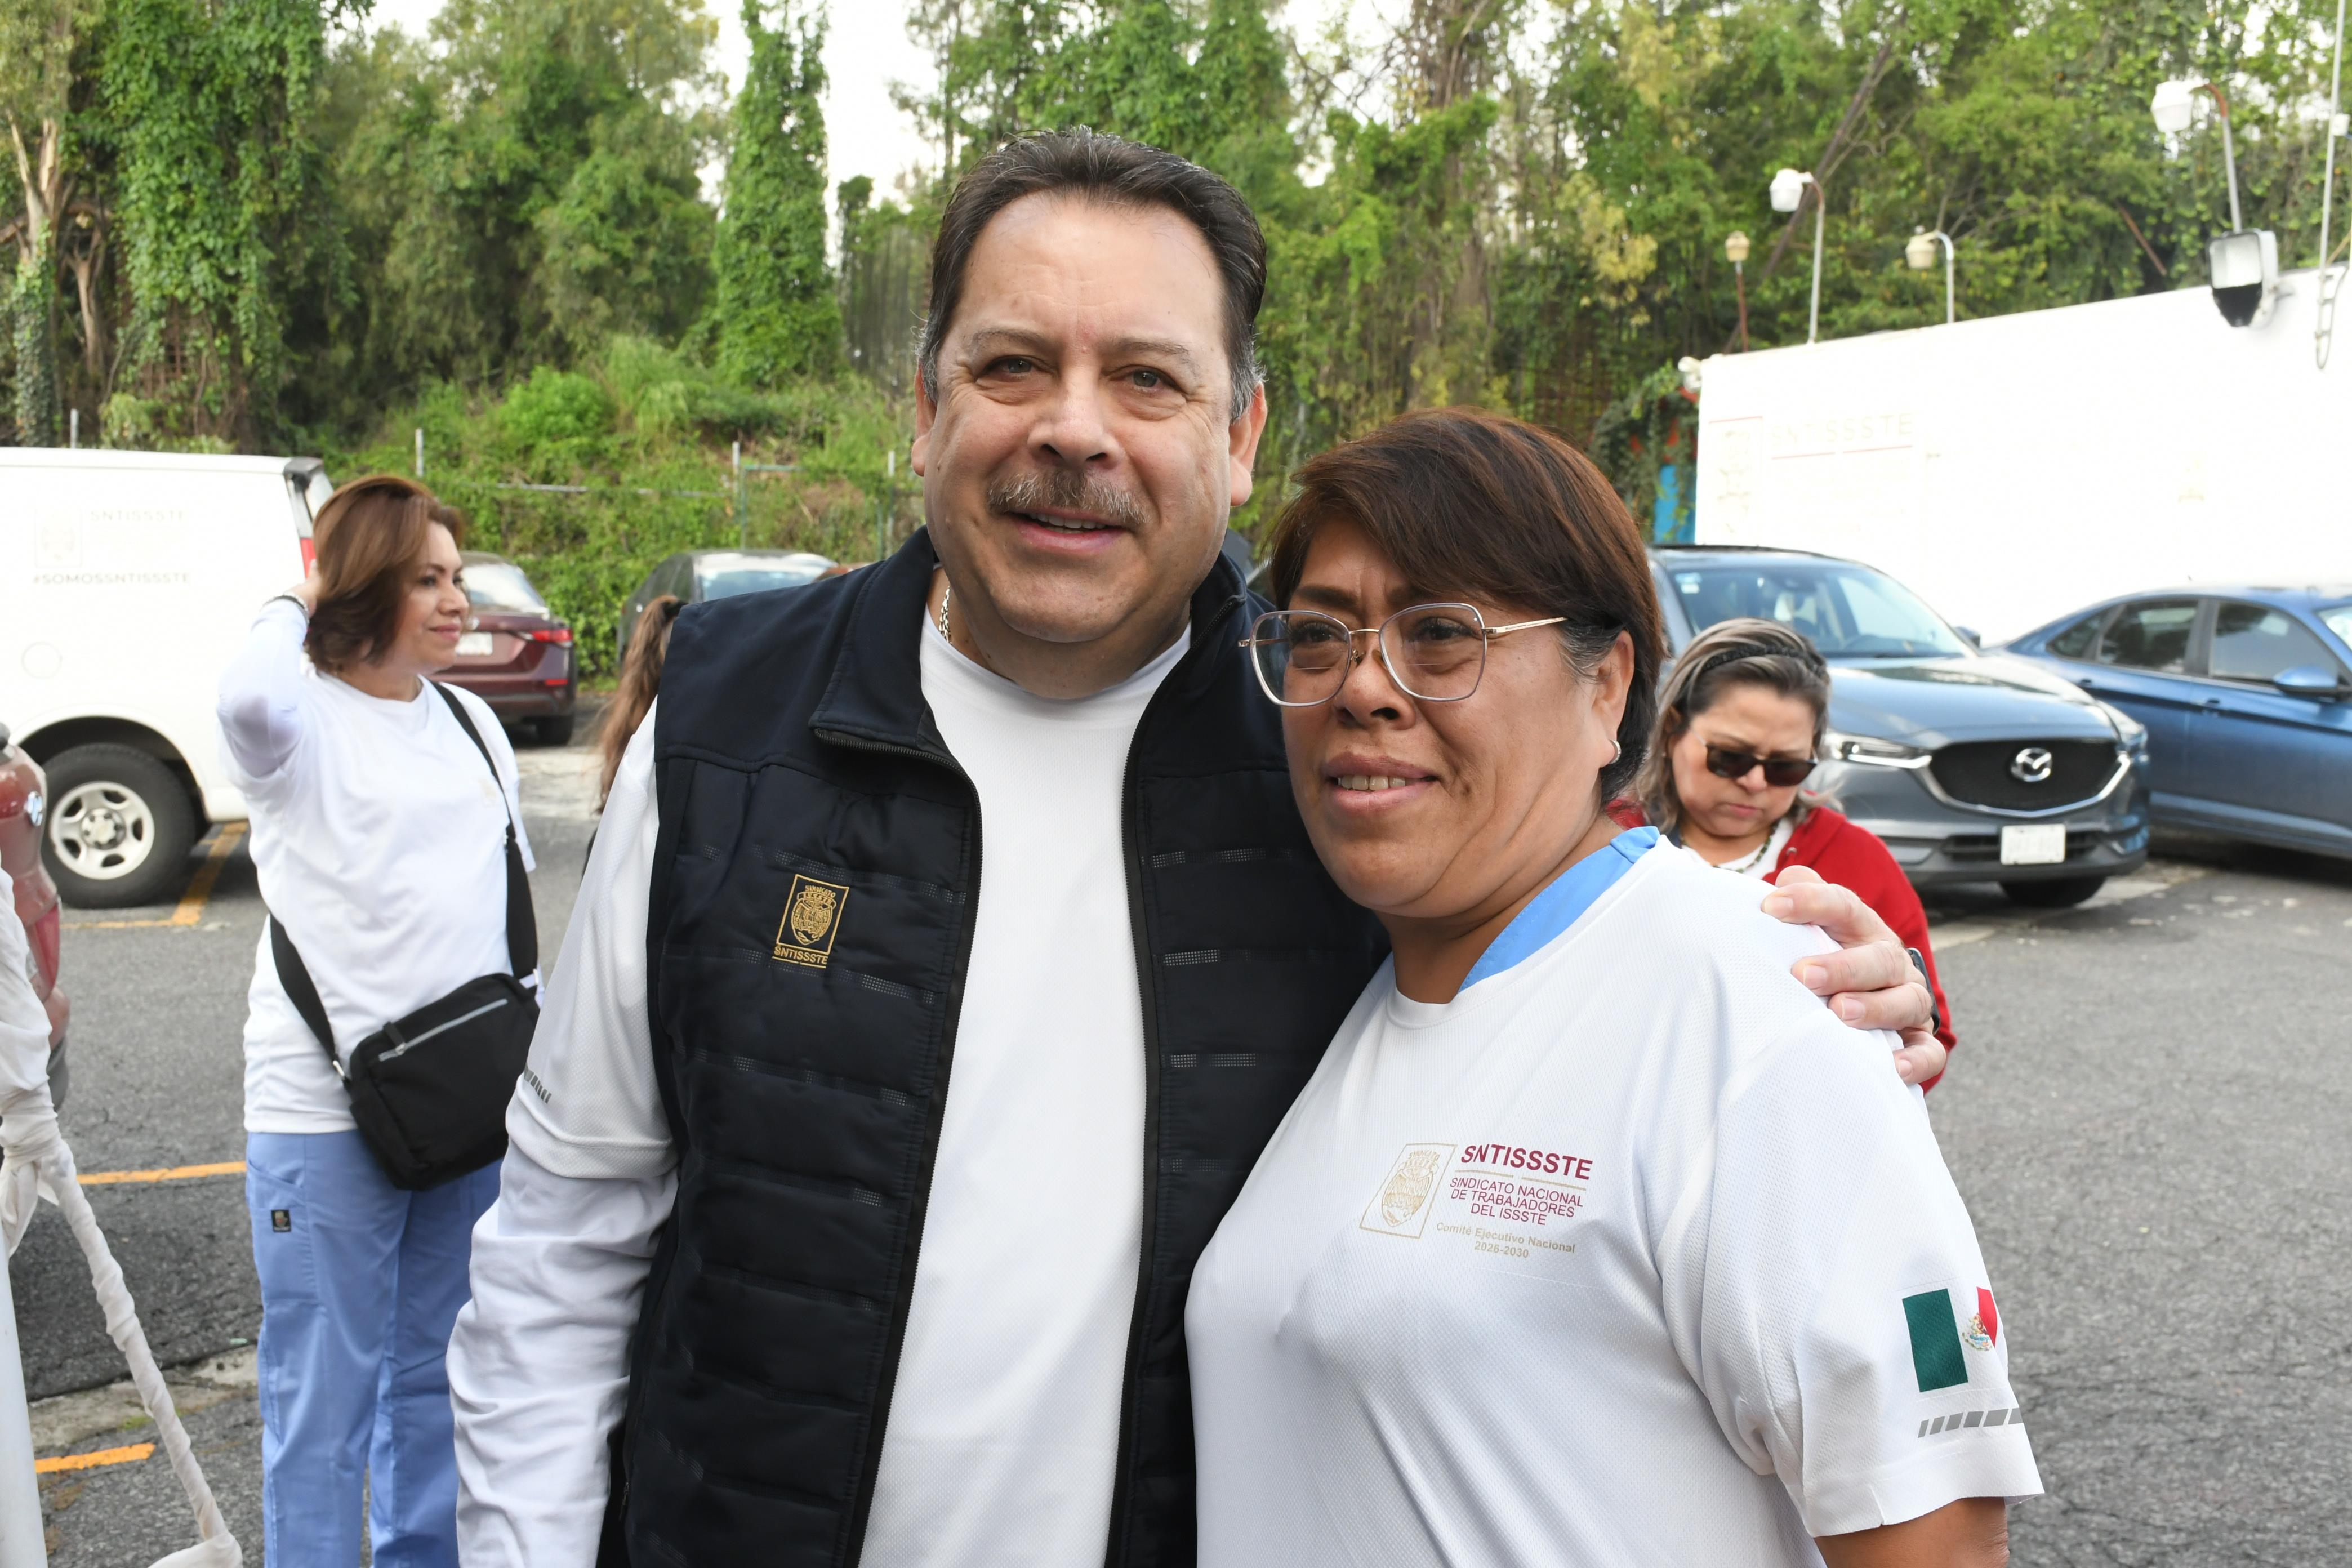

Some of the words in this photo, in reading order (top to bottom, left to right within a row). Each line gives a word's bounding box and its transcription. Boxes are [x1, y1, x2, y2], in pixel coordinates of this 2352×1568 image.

[90, 509, 186, 522] SNTISSSTE
[33, 572, 190, 585] #SOMOSSNTISSSTE
[805, 885, 836, 898] SINDICATO
[774, 946, 829, 964] SNTISSSTE
[1461, 1144, 1593, 1180] SNTISSSTE
[1450, 1177, 1514, 1194] SINDICATO
[1517, 1185, 1583, 1207] NACIONAL
[1451, 1188, 1468, 1200] DE
[1471, 1190, 1575, 1218] TRABAJADORES
[1471, 1203, 1495, 1217] DEL
[1499, 1207, 1547, 1226] ISSSTE
[1436, 1222, 1472, 1236] Comité
[1475, 1227, 1525, 1244] Ejecutivo
[1527, 1236, 1576, 1253] Nacional
[1474, 1241, 1529, 1258] 2026-2030
